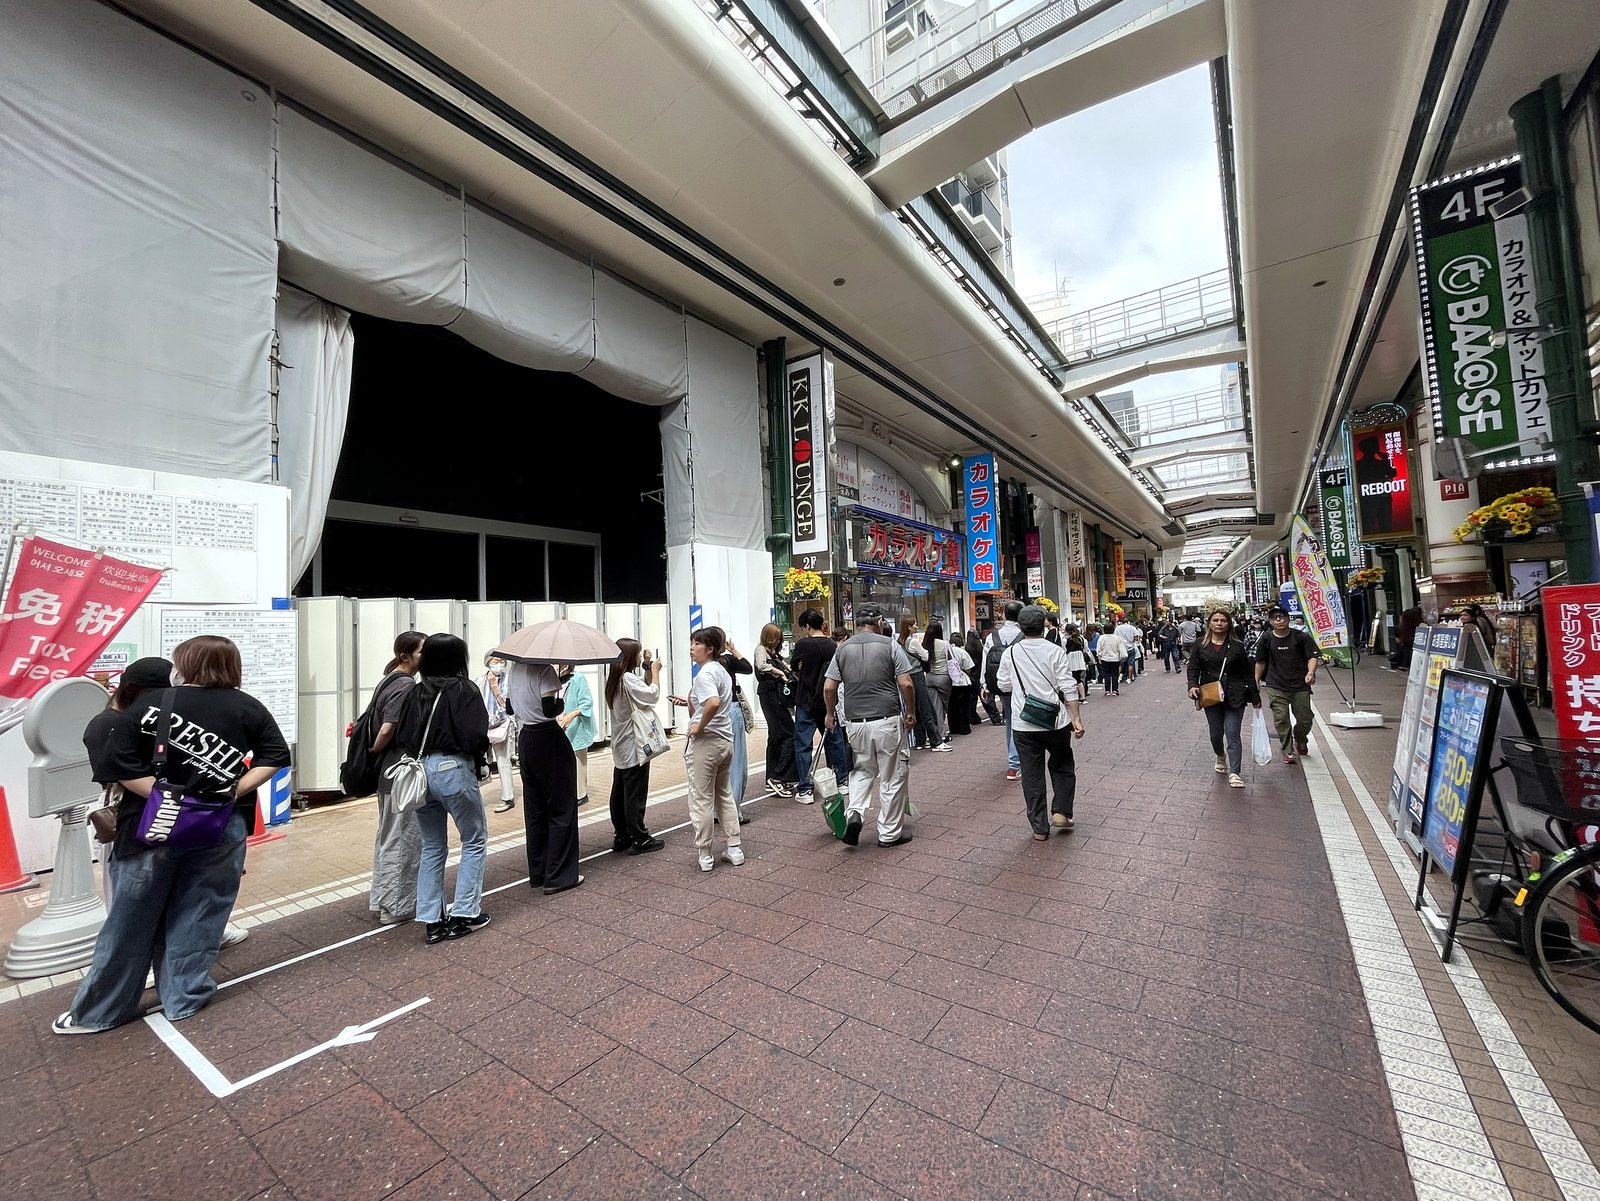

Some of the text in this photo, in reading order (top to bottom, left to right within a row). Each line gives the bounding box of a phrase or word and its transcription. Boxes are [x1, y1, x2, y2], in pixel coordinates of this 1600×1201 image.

[1440, 178, 1505, 222] 4F
[1325, 472, 1346, 485] 4F
[1361, 480, 1406, 497] REBOOT
[1445, 483, 1466, 494] PIA
[969, 462, 994, 583] カラオケ館
[32, 546, 92, 568] WELCOME
[868, 521, 961, 573] カラオケ館
[802, 557, 818, 571] 2F
[12, 585, 127, 638] 免税
[28, 635, 77, 662] Tax
[1560, 603, 1586, 668] ドリンク
